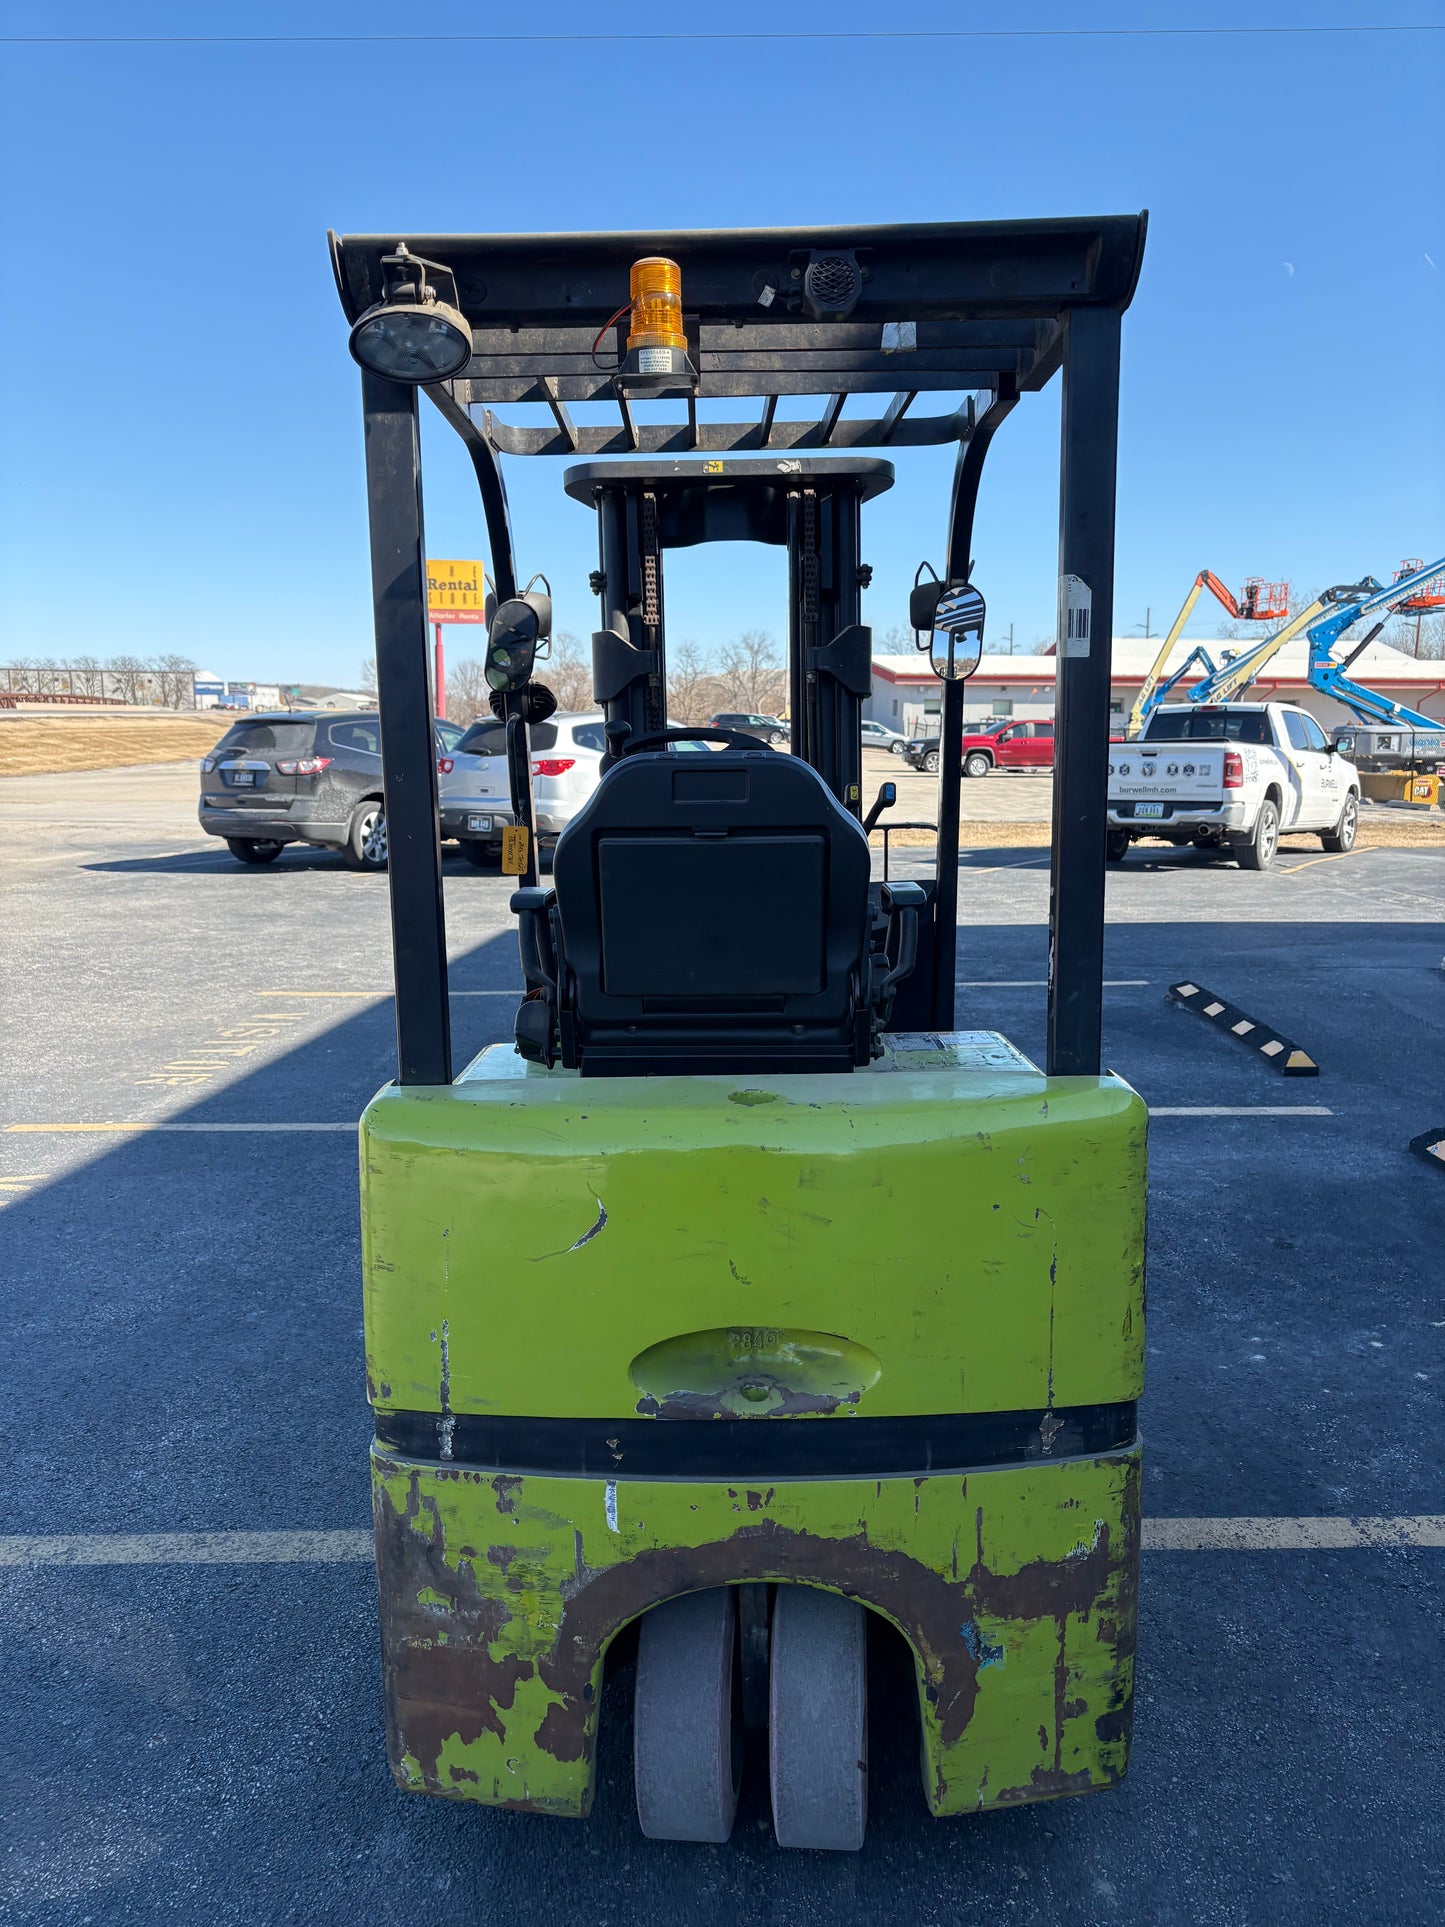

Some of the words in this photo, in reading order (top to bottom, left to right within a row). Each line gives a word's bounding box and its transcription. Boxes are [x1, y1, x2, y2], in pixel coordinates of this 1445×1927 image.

[427, 578, 478, 591] Rental
[1144, 675, 1155, 693] LIFT
[1223, 678, 1239, 694] LIFT
[1414, 786, 1429, 796] CAT
